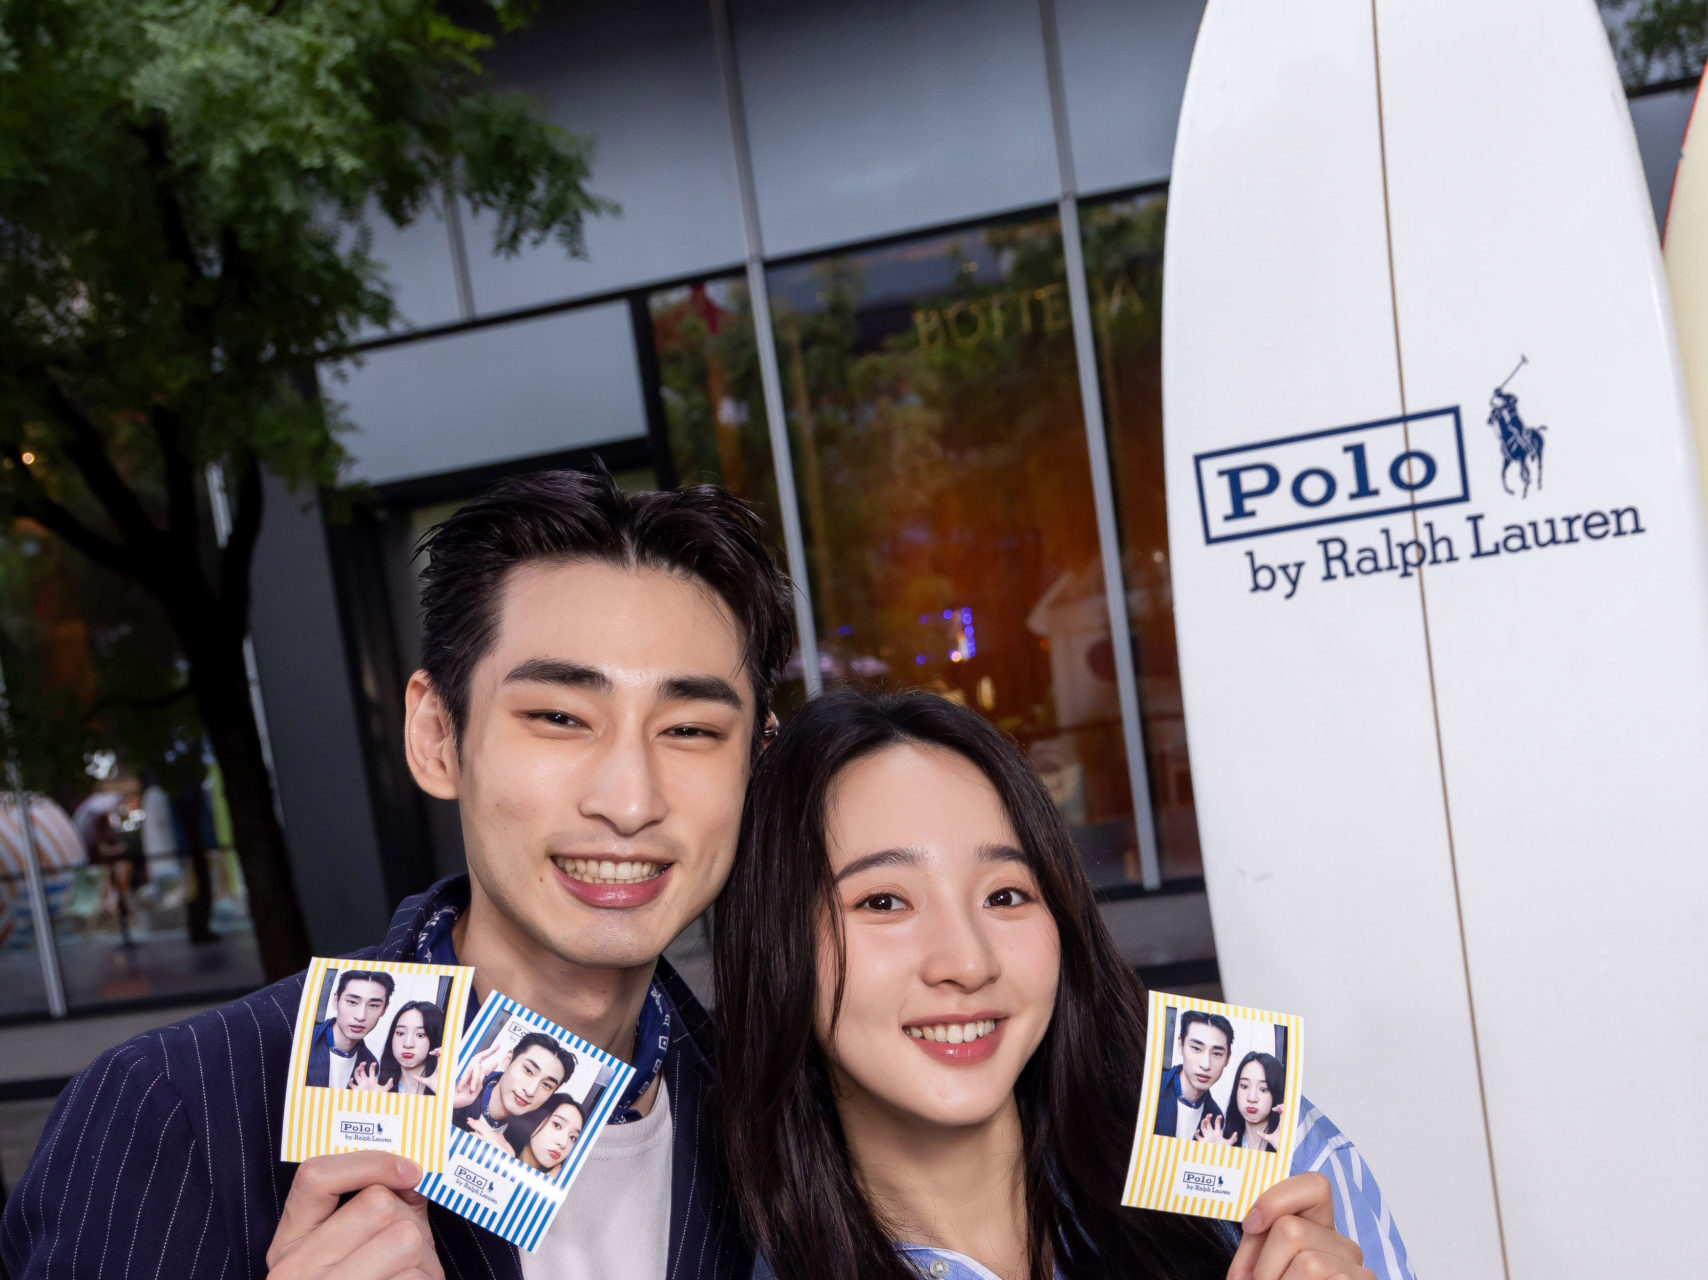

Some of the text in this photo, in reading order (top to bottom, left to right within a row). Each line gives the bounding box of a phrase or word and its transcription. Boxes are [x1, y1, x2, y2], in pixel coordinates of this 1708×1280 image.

[914, 272, 1143, 350] BOTTEA
[1216, 441, 1439, 522] Polo
[1245, 504, 1647, 599] by Ralph Lauren
[344, 1123, 371, 1133] Polo
[354, 1134, 371, 1142] Ralph
[458, 1168, 483, 1186] Polo
[1186, 1174, 1212, 1184] Polo
